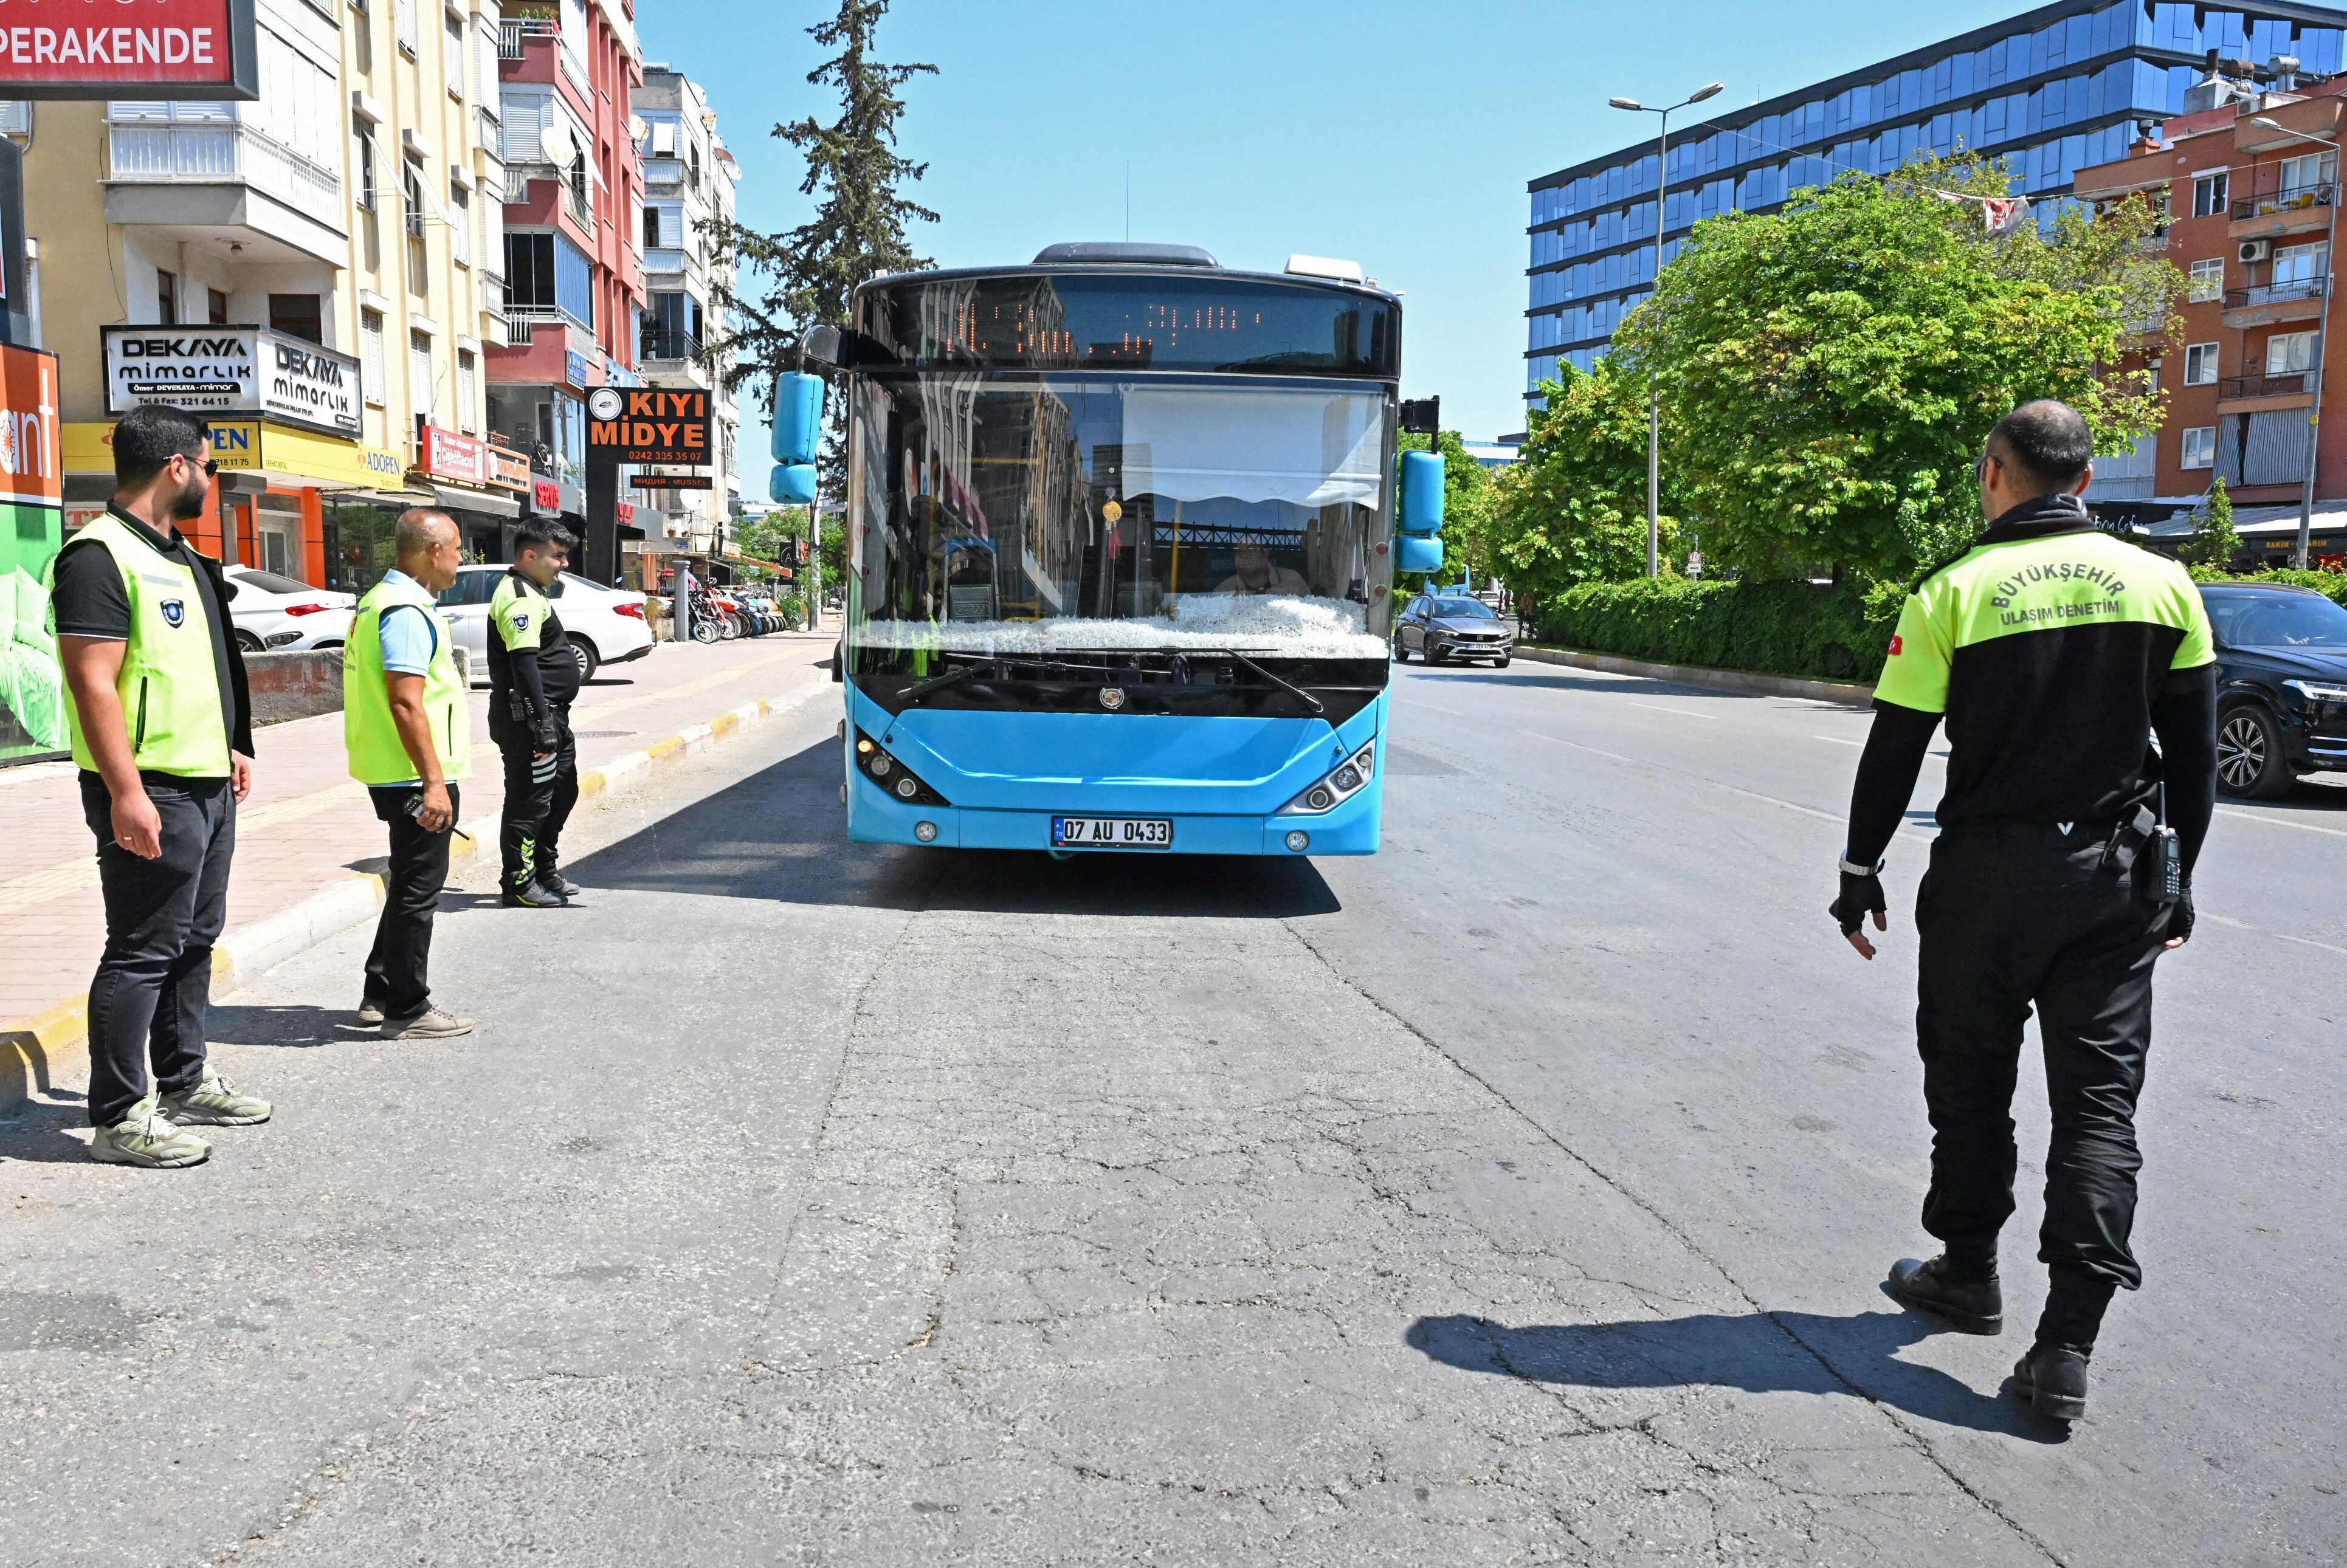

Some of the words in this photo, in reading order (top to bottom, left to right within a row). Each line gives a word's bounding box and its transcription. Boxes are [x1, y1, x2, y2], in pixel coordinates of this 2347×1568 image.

[122, 339, 247, 357] DEKAYA
[275, 343, 343, 387] DEKAYA
[629, 392, 704, 418] KIYI
[591, 415, 704, 447] MİDYE
[367, 451, 399, 475] ADOPEN
[629, 451, 652, 459] 0242
[655, 452, 672, 461] 335
[676, 452, 688, 461] 35
[690, 452, 701, 461] 07
[1991, 563, 2125, 608] BÜYÜKŞEHİR
[2001, 607, 2053, 625] ULAŞIM
[2057, 599, 2119, 618] DENETİM
[1064, 821, 1085, 840] 07
[1092, 822, 1114, 841] AU
[1124, 822, 1167, 842] 0433
